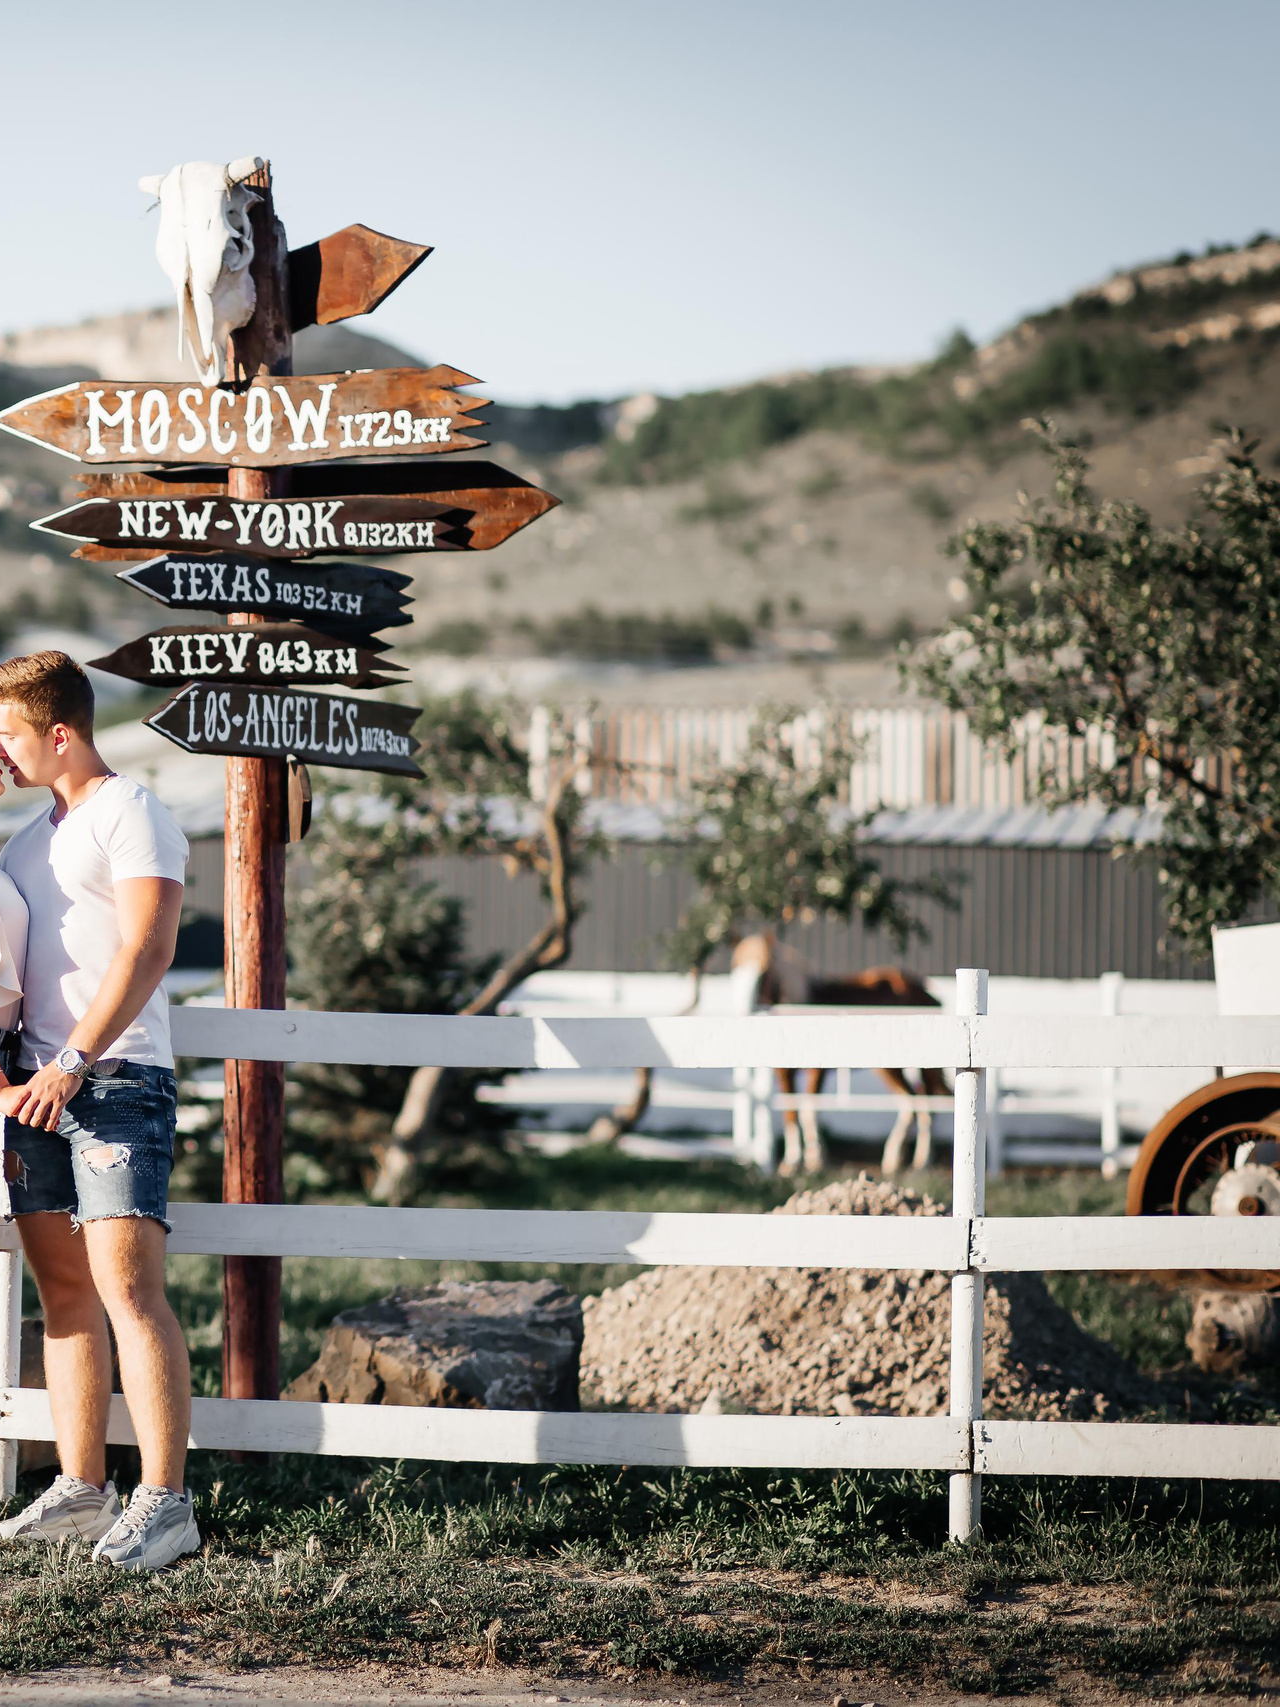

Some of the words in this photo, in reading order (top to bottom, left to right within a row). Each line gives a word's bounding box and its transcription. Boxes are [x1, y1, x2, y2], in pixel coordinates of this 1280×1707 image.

[83, 382, 338, 456] MOSCOW
[337, 409, 453, 449] 1729KM
[117, 500, 346, 550] NEW-YORK
[165, 562, 271, 604] TEXAS
[148, 632, 255, 676] KIEV
[257, 640, 358, 675] 843KM
[186, 689, 359, 757] LOS-ANGELES
